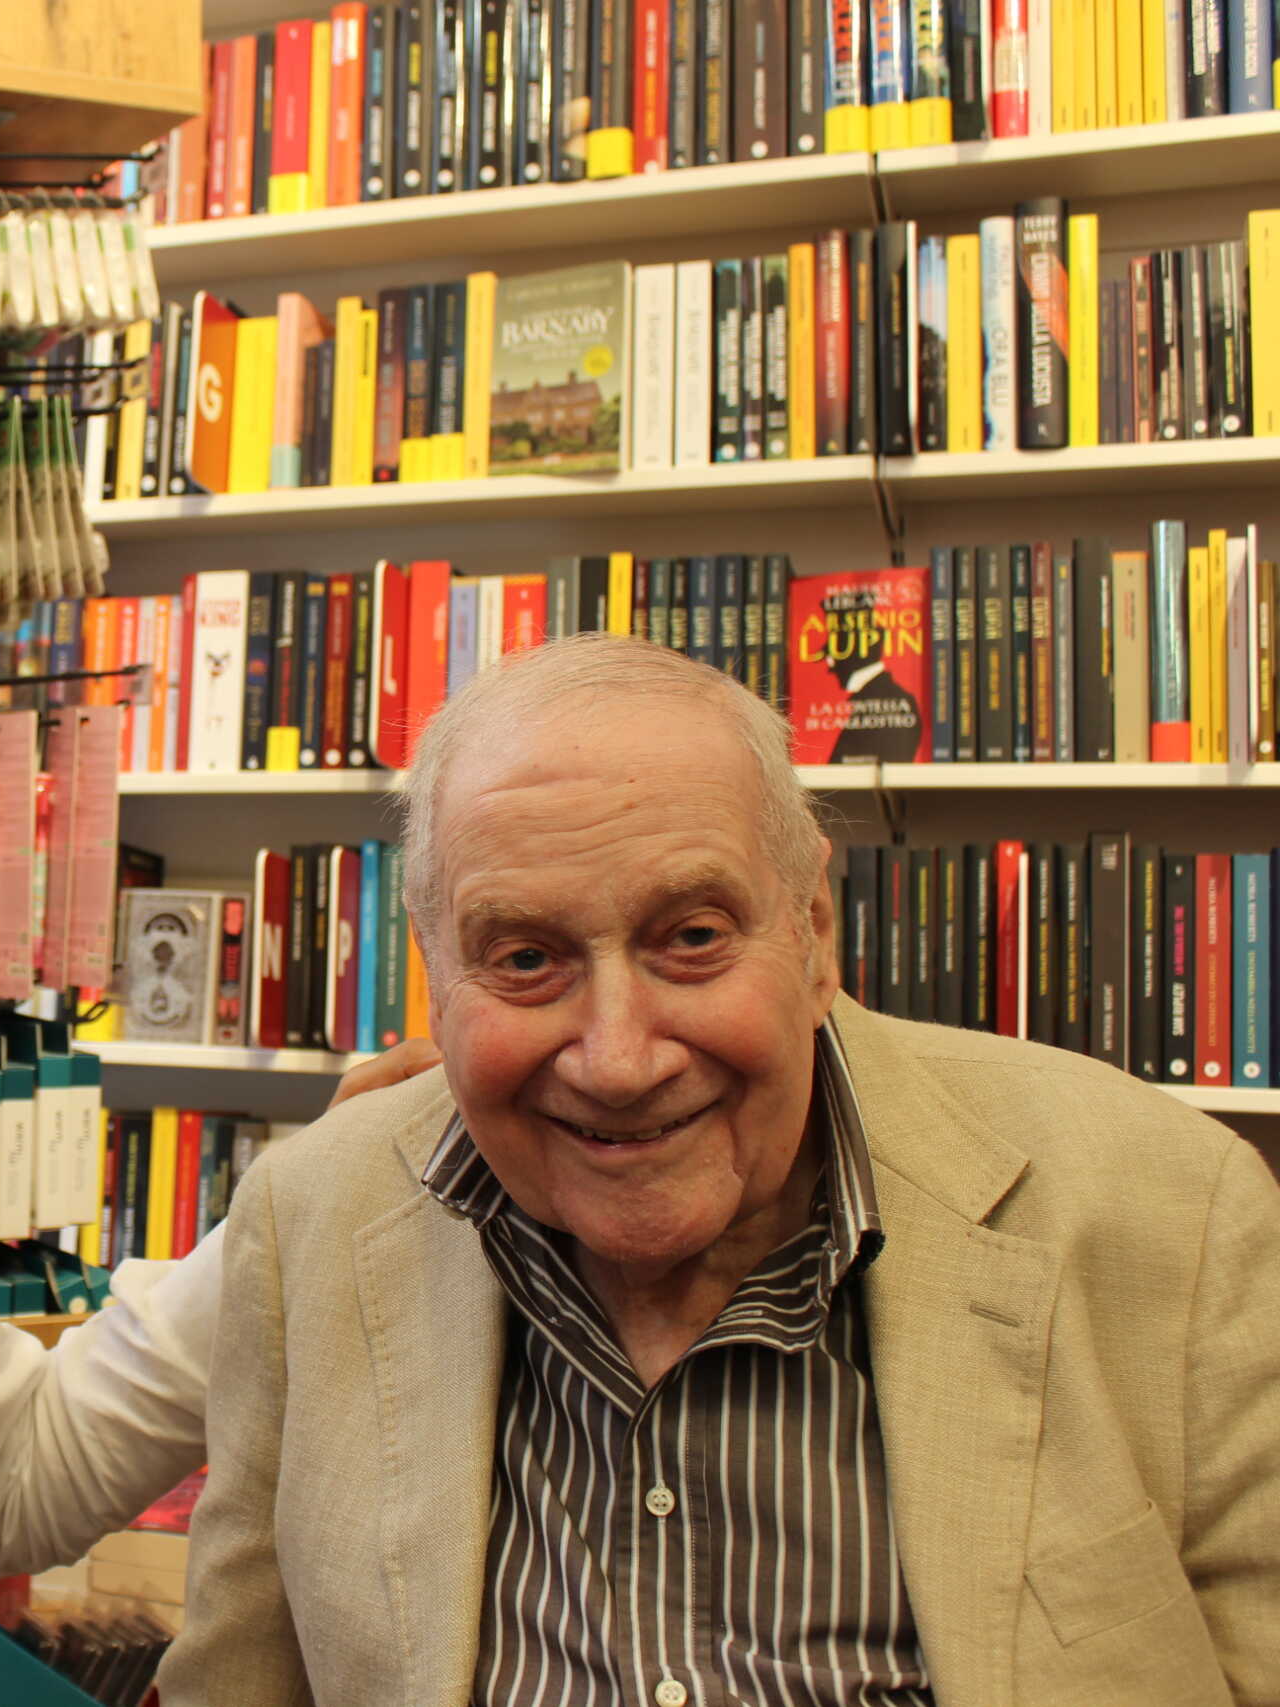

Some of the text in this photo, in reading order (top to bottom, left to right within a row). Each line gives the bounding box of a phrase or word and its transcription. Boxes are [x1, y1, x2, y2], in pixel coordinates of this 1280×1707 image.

[500, 305, 616, 348] BARNABY
[199, 362, 223, 423] G
[1031, 347, 1053, 407] LOCUSTA
[801, 608, 921, 633] ARSENIO
[799, 628, 924, 662] LUPIN
[810, 699, 912, 716] LA CONTESSA
[262, 923, 283, 981] N
[337, 920, 354, 977] P
[1172, 983, 1185, 1015] RIPLEY
